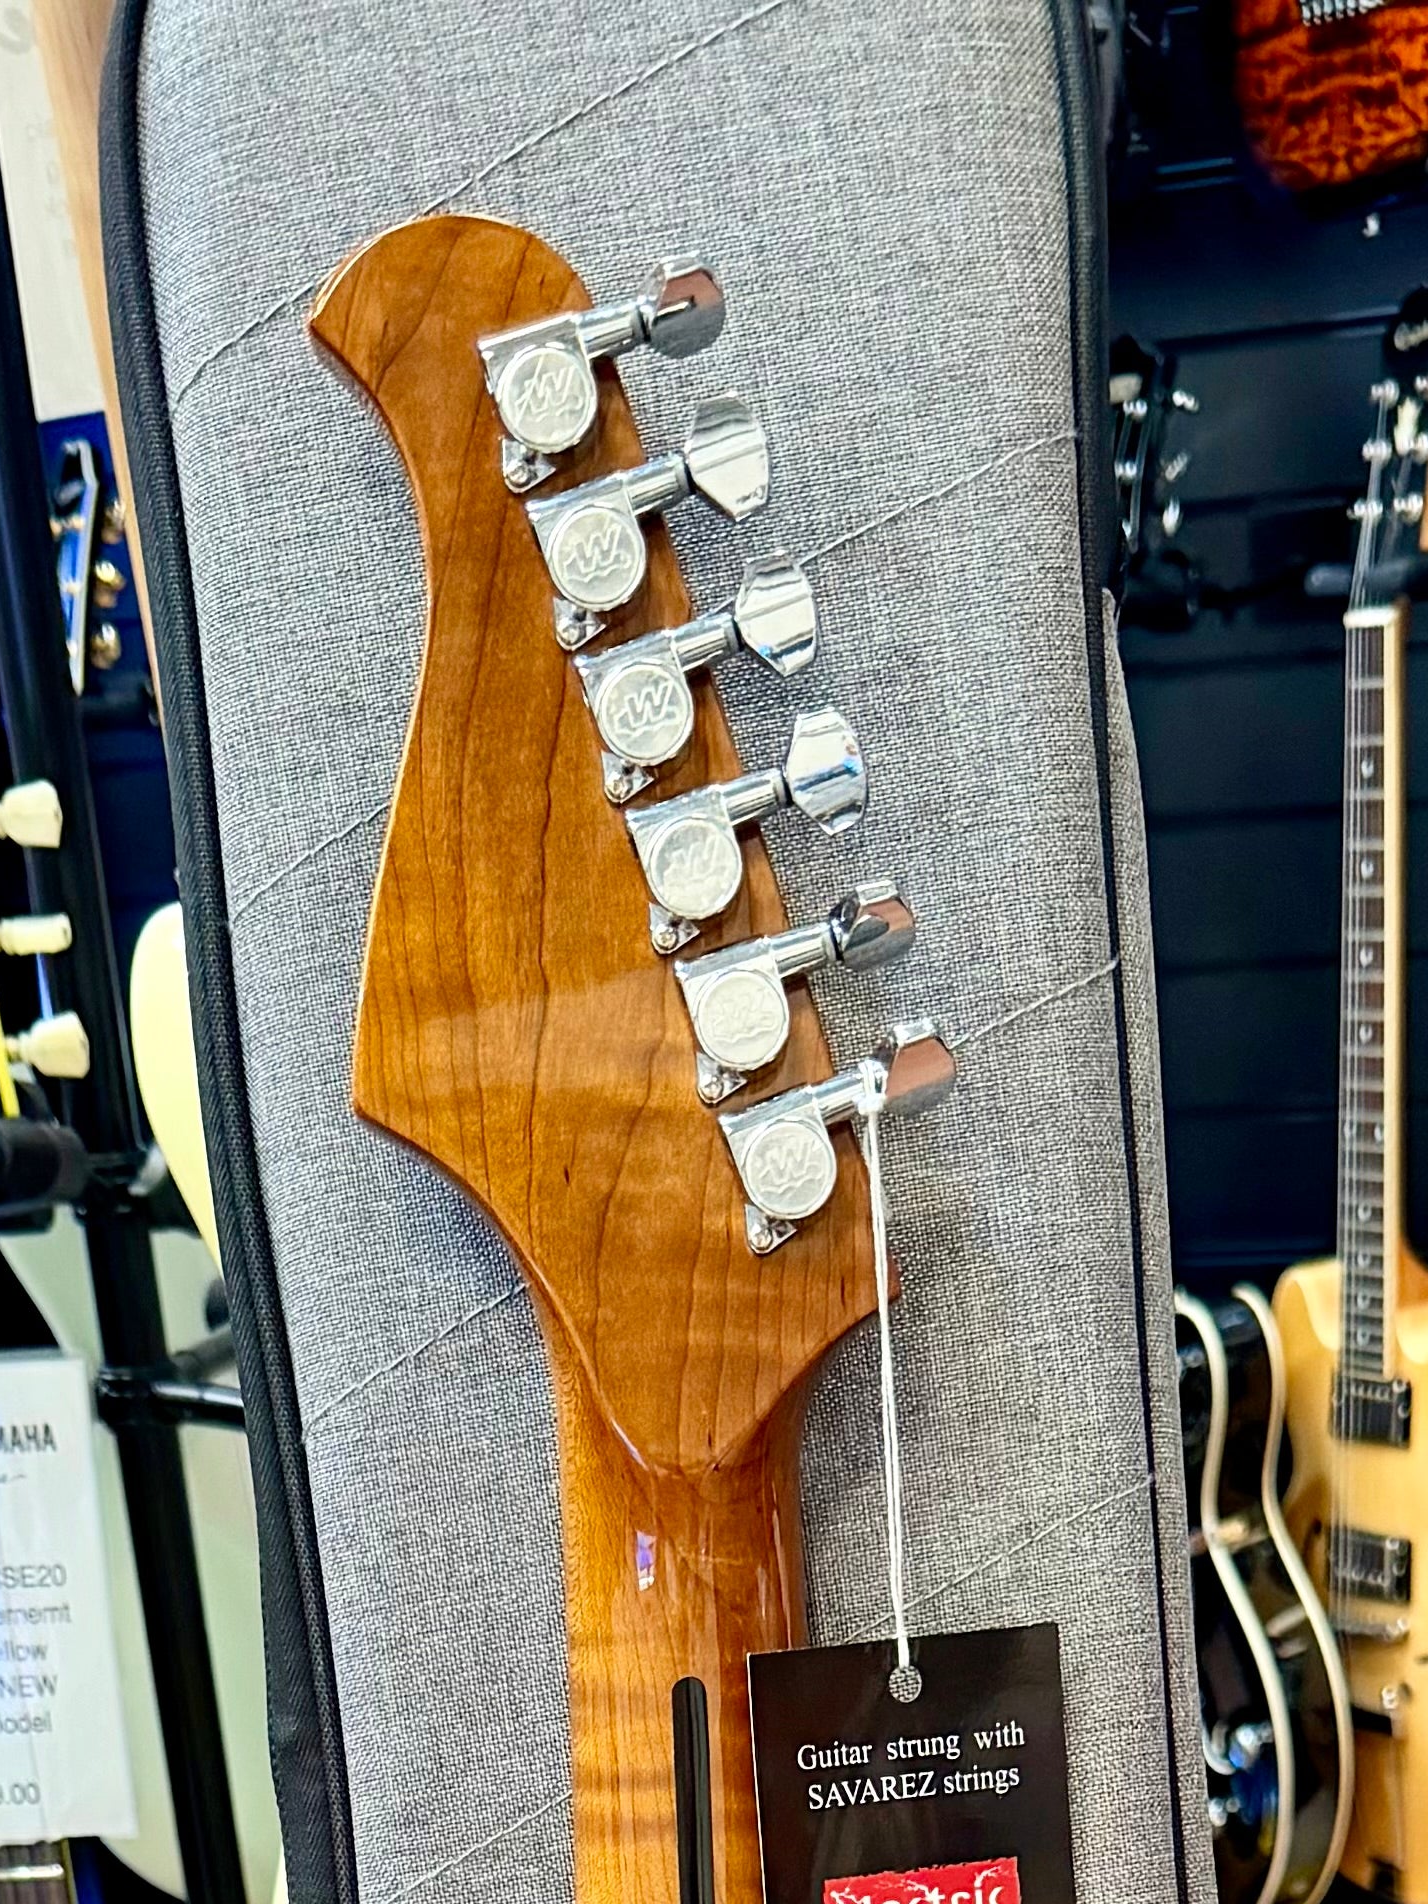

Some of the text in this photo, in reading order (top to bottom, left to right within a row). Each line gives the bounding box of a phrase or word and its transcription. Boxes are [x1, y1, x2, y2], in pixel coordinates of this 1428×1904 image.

[797, 1720, 1026, 1771] Guitar strung with
[808, 1764, 1021, 1811] SAVAREZ strings
